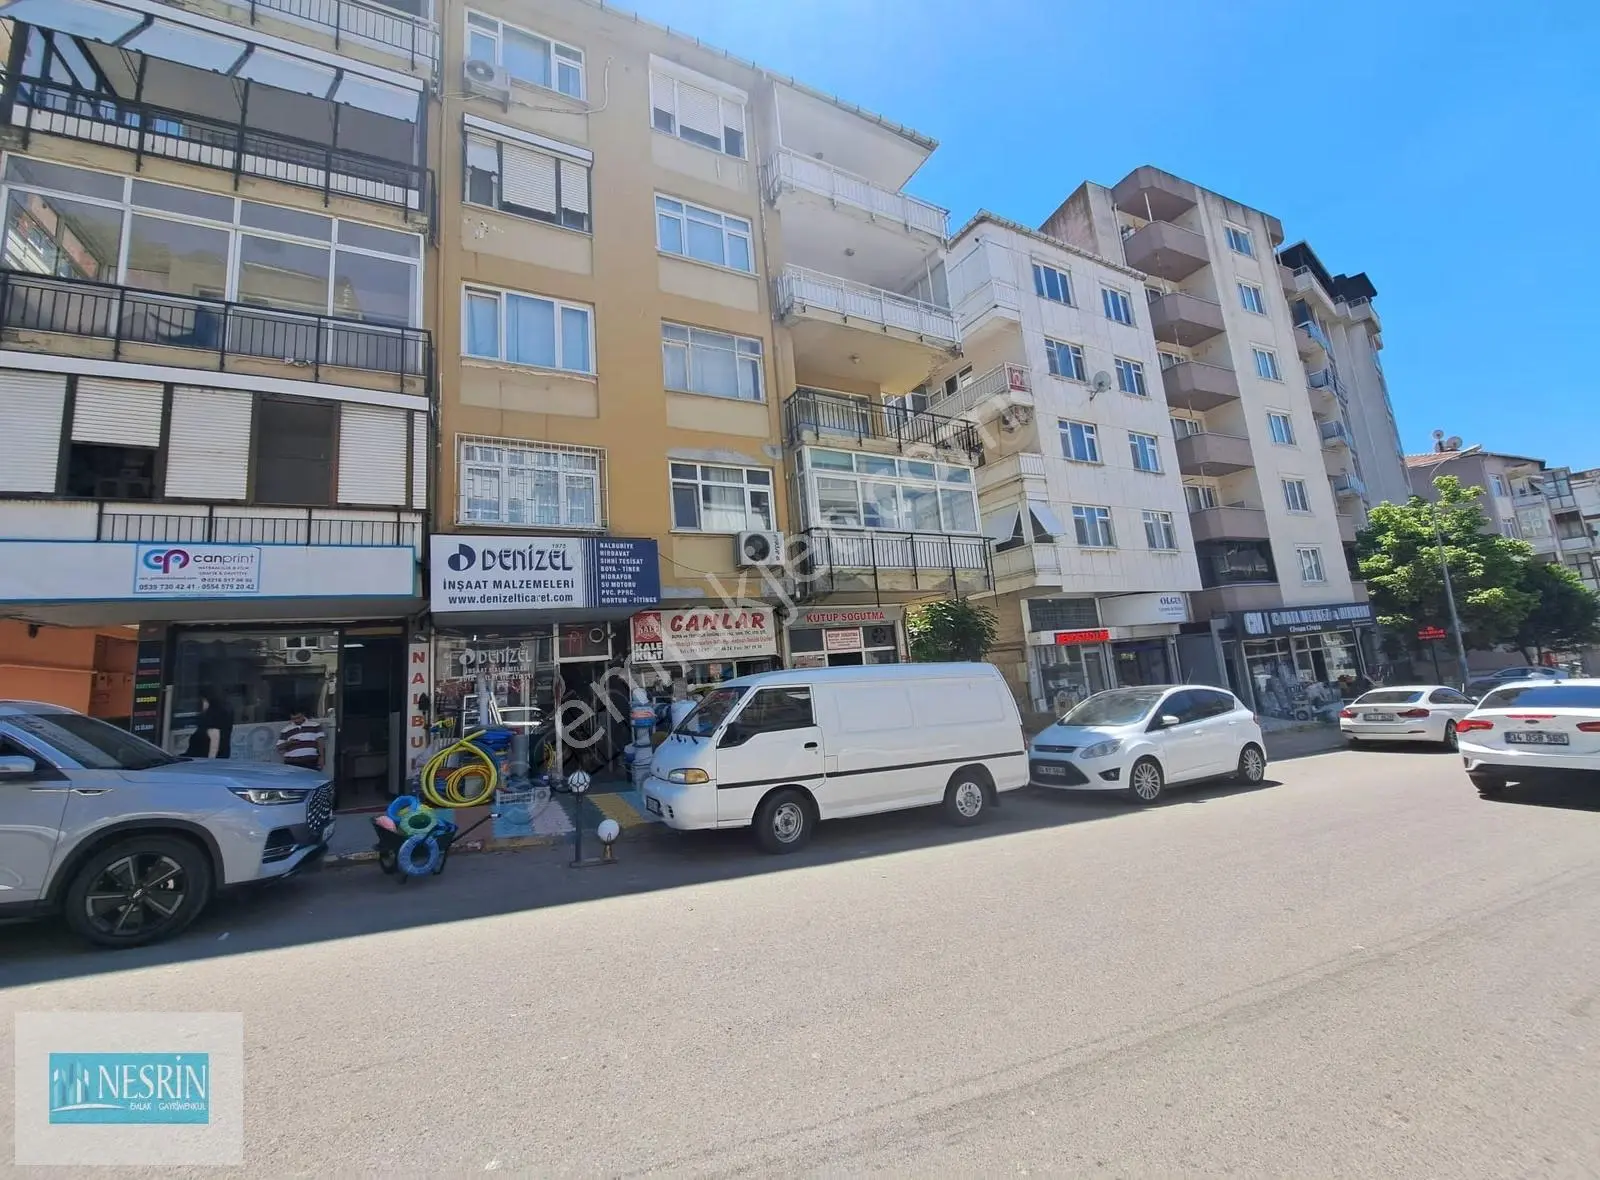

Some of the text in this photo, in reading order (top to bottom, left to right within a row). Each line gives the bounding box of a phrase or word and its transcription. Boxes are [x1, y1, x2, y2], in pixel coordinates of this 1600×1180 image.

[193, 553, 255, 565] canprint
[481, 543, 573, 571] DENİZEL
[443, 578, 574, 592] İNŞAAT MALZEMELERİ
[448, 593, 573, 604] www.denizelticaret.com
[670, 612, 765, 632] CANLAR
[806, 612, 839, 622] KUTUP
[634, 642, 663, 651] KALE
